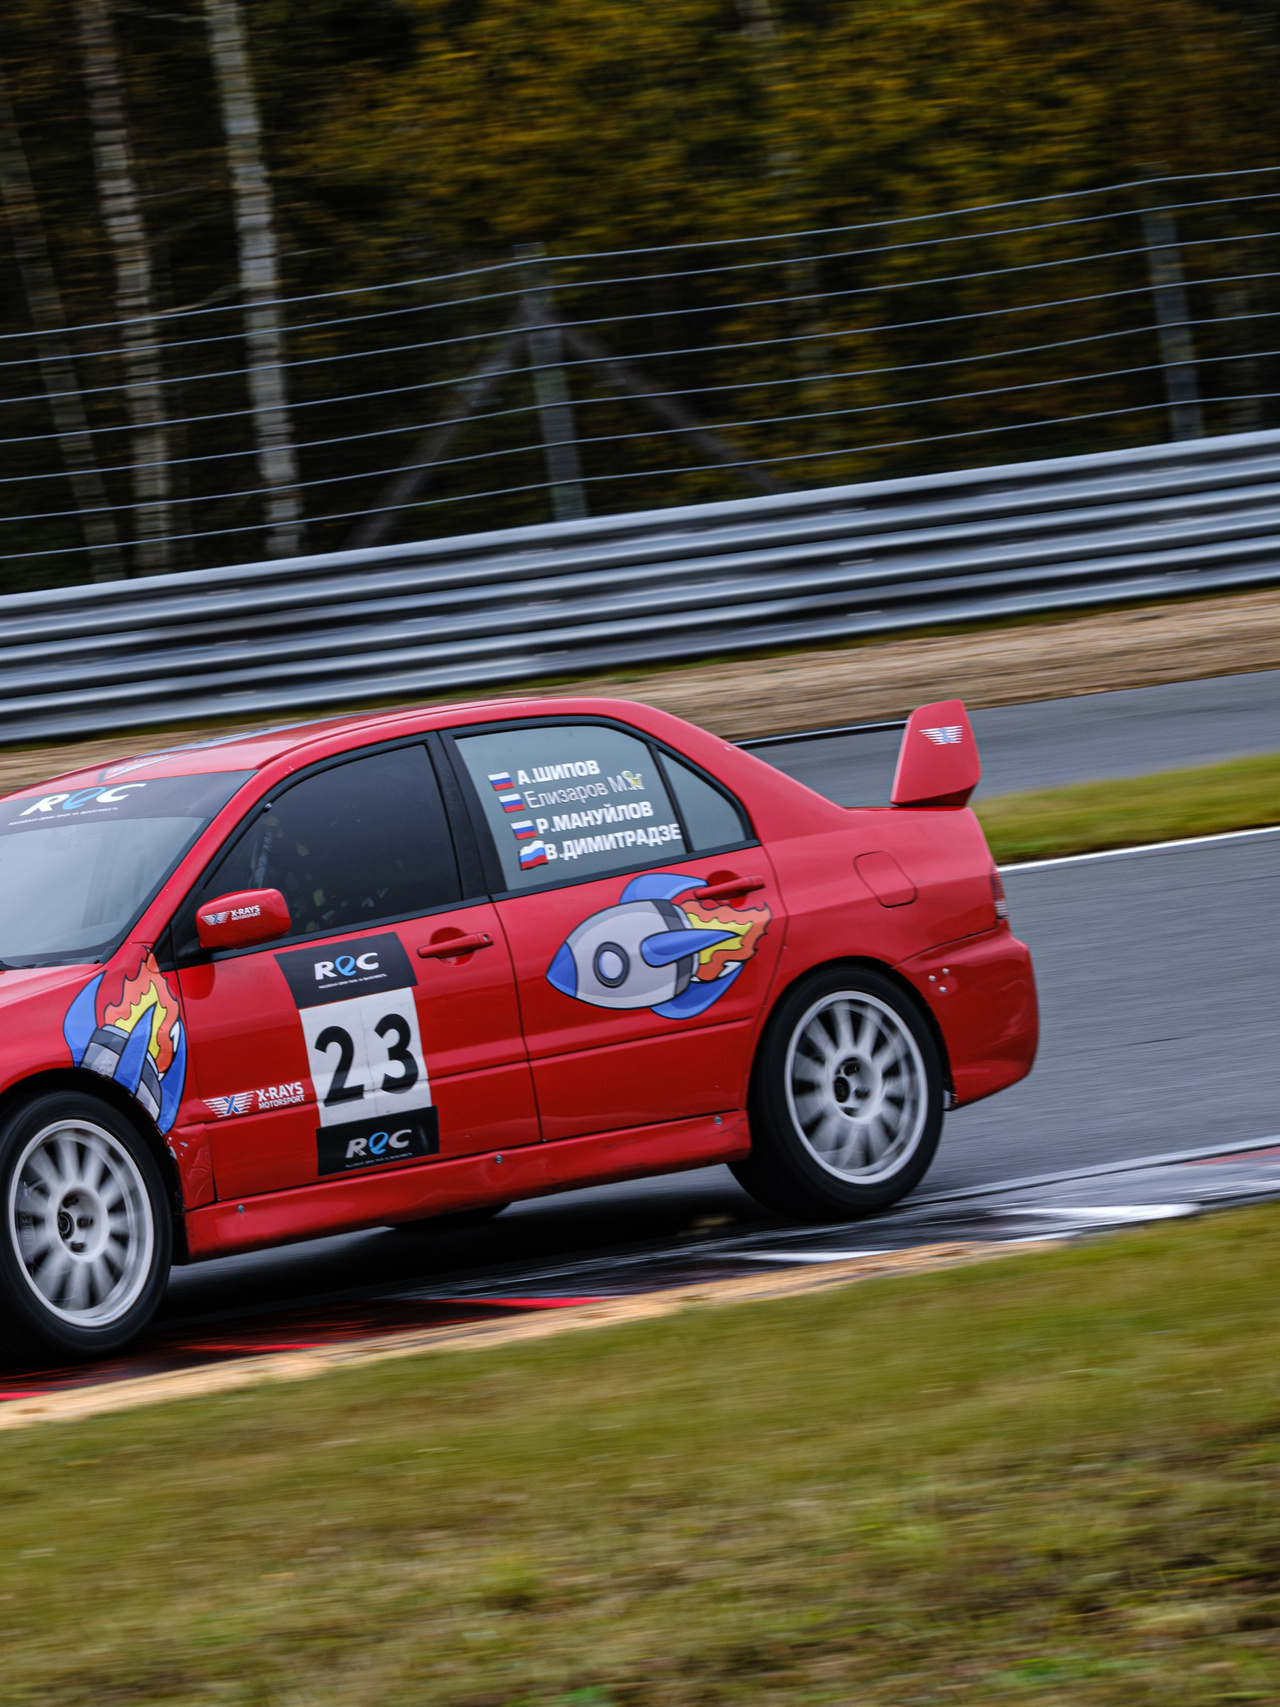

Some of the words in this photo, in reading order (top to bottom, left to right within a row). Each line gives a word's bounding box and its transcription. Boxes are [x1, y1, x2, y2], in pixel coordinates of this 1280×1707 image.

[517, 760, 601, 786] А.ШИПОВ
[523, 782, 609, 809] Елизаров
[535, 801, 654, 835] Р.МАНУЙЛОВ
[544, 823, 682, 861] В.ДИМИТРАДЗЕ
[230, 904, 261, 917] X-RAYS
[314, 1013, 419, 1108] 23
[255, 1081, 304, 1102] X-RAYS
[257, 1093, 305, 1110] MOTORSPORT
